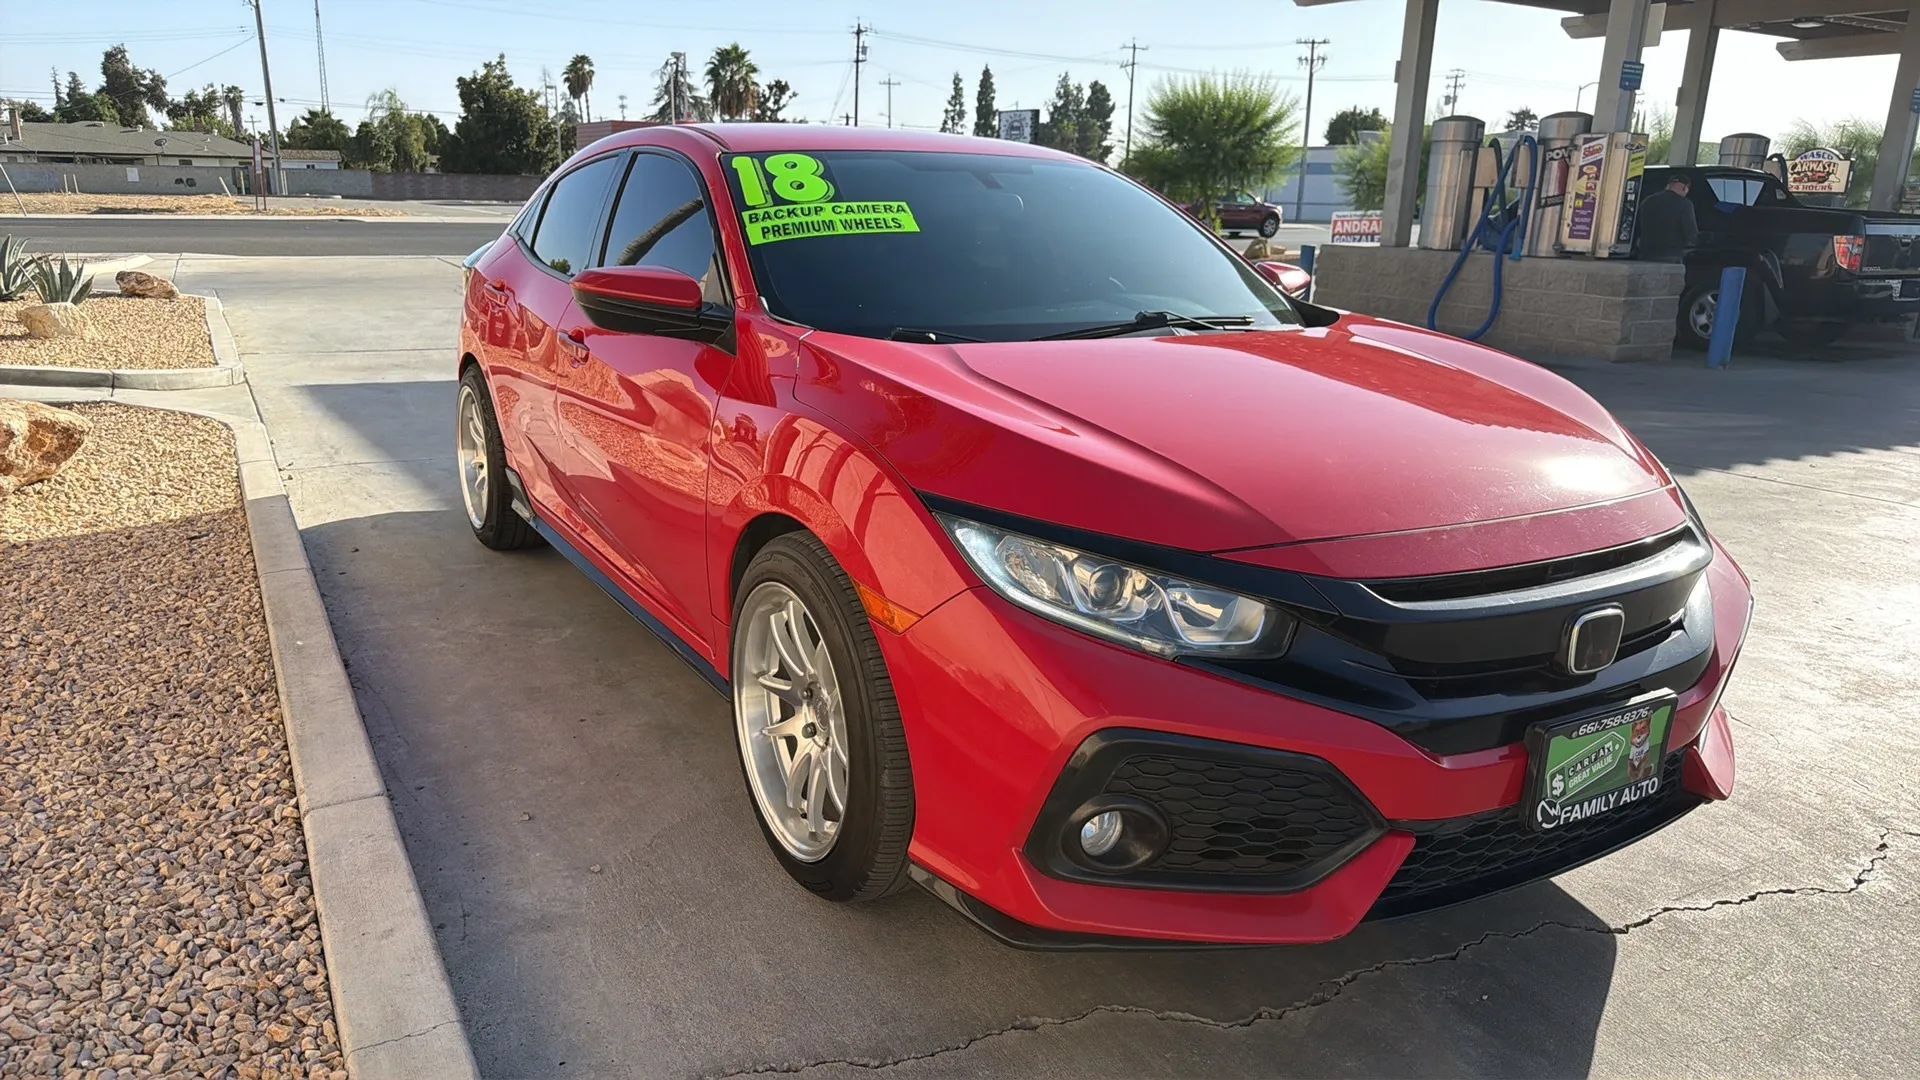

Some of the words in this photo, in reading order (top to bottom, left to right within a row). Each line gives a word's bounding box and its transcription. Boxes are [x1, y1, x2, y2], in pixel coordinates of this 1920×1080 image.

[1800, 151, 1834, 160] WASCO
[732, 153, 835, 207] 18
[749, 205, 823, 223] BACKUP
[832, 204, 907, 215] CAMERA
[761, 219, 837, 239] PREMIUM
[842, 217, 903, 231] WHEELS
[1578, 706, 1650, 735] 661-758-8376
[1568, 768, 1590, 788] GREAT
[1591, 754, 1613, 773] VALUE
[1560, 792, 1618, 825] FAMILY
[1619, 777, 1658, 806] AUTO
